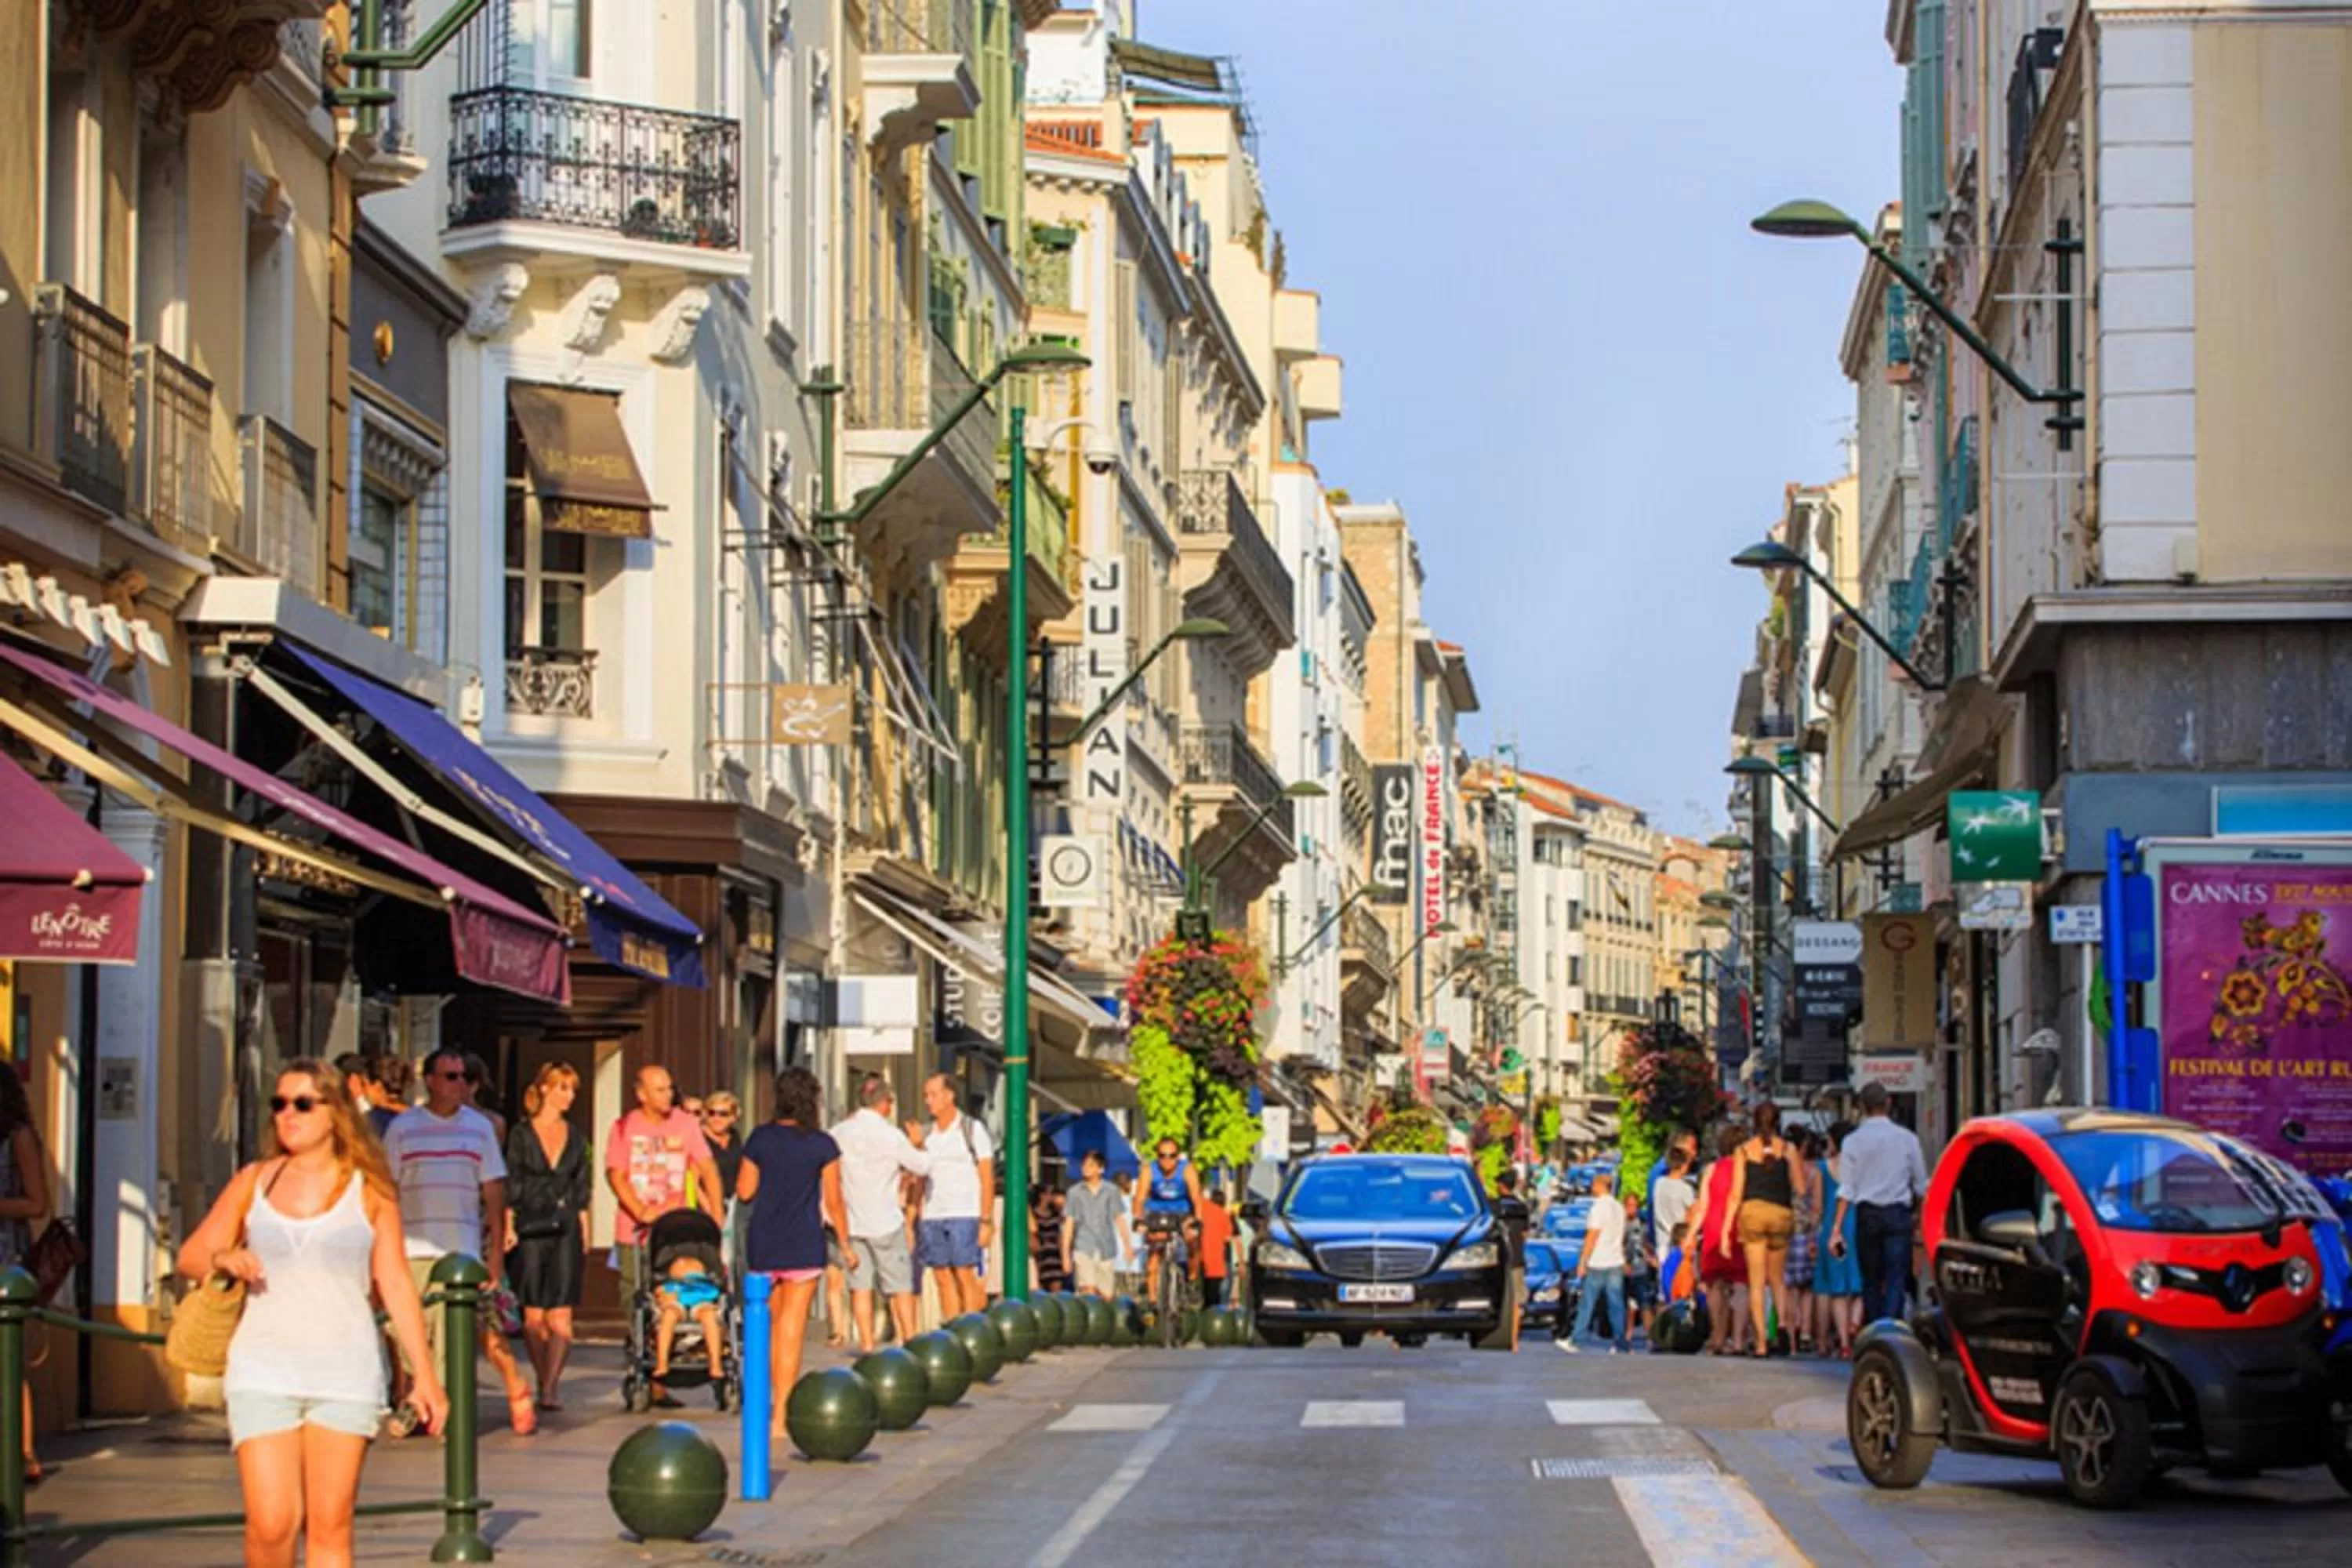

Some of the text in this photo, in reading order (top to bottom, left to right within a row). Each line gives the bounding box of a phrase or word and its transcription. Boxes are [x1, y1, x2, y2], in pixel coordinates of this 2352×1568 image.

[1087, 561, 1121, 798] JULIAN
[1374, 776, 1409, 889] fnac
[1423, 764, 1441, 938] HOTEL de FRANCE
[31, 902, 112, 942] LENÔTRE
[2169, 881, 2269, 904] CANNES
[943, 935, 965, 1029] STUD
[2169, 1059, 2245, 1076] FESTIVAL
[2249, 1060, 2272, 1076] DE
[2279, 1060, 2326, 1078] L'ART
